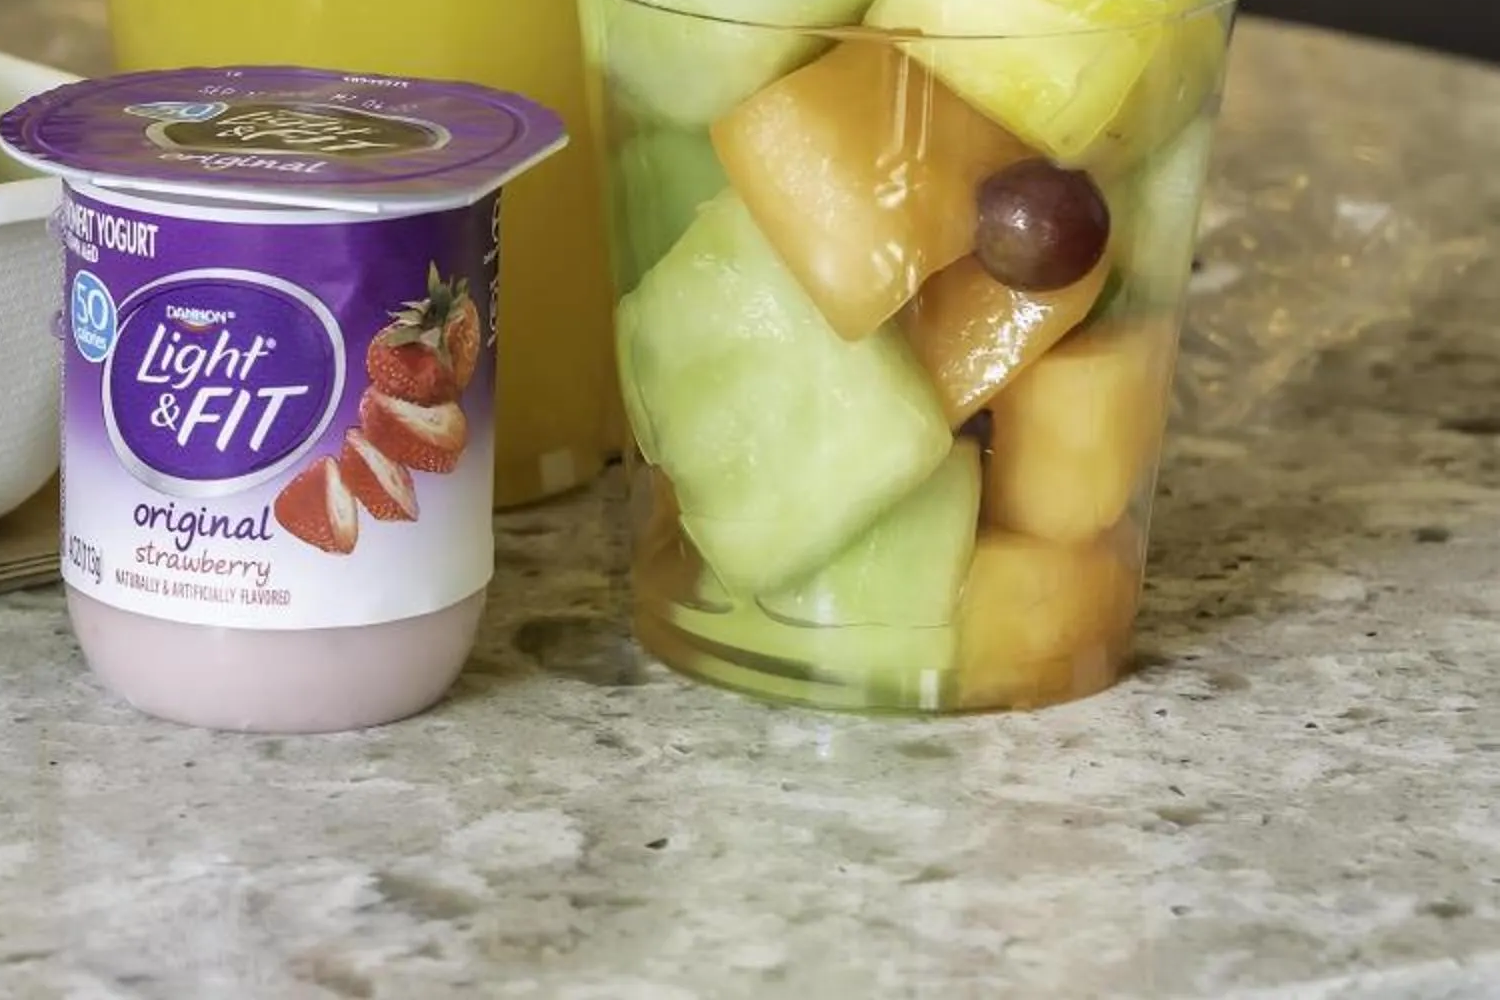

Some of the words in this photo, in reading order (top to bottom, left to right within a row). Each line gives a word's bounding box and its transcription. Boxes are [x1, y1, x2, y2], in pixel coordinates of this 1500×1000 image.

[97, 212, 159, 259] YOGURT
[76, 282, 108, 331] 50
[137, 323, 269, 389] Light
[133, 502, 274, 551] original
[115, 568, 159, 594] NATURALLY
[161, 578, 169, 595] &
[171, 581, 237, 604] ARTIFICIALLY
[240, 588, 291, 606] FLAVORED
[135, 541, 271, 587] strawberry
